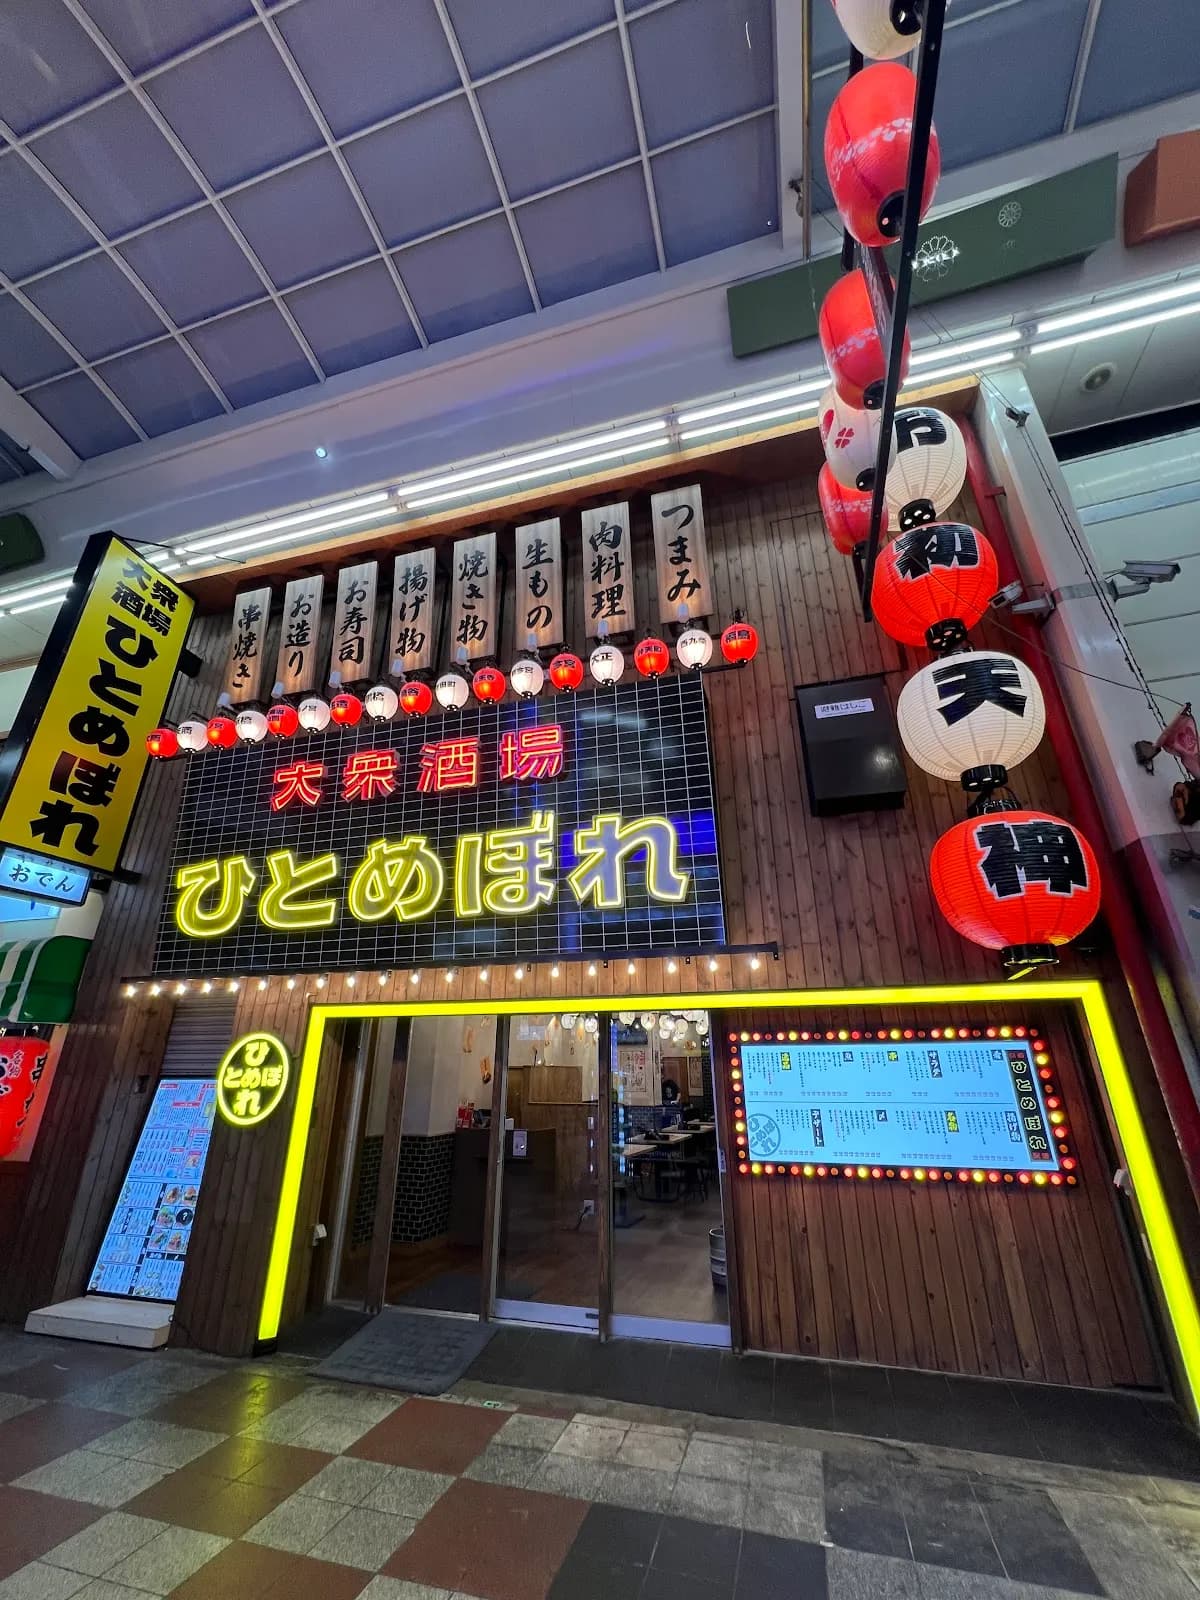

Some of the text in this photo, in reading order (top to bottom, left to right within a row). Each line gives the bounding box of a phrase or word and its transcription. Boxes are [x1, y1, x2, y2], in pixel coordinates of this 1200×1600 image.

[456, 549, 489, 643] 焼き物
[521, 538, 554, 630] 生もの
[588, 522, 626, 619] 肉料理
[661, 503, 702, 602] つまみ
[232, 605, 261, 689] 串焼き
[285, 592, 312, 678] お造り
[337, 579, 368, 664] お寿司
[395, 562, 428, 656] 揚げ物
[592, 653, 613, 665] 大正
[30, 616, 159, 856] ひとめぼれ
[271, 724, 565, 811] 大衆酒場
[9, 864, 75, 892] おでん
[176, 811, 691, 938] ひとめぼれ
